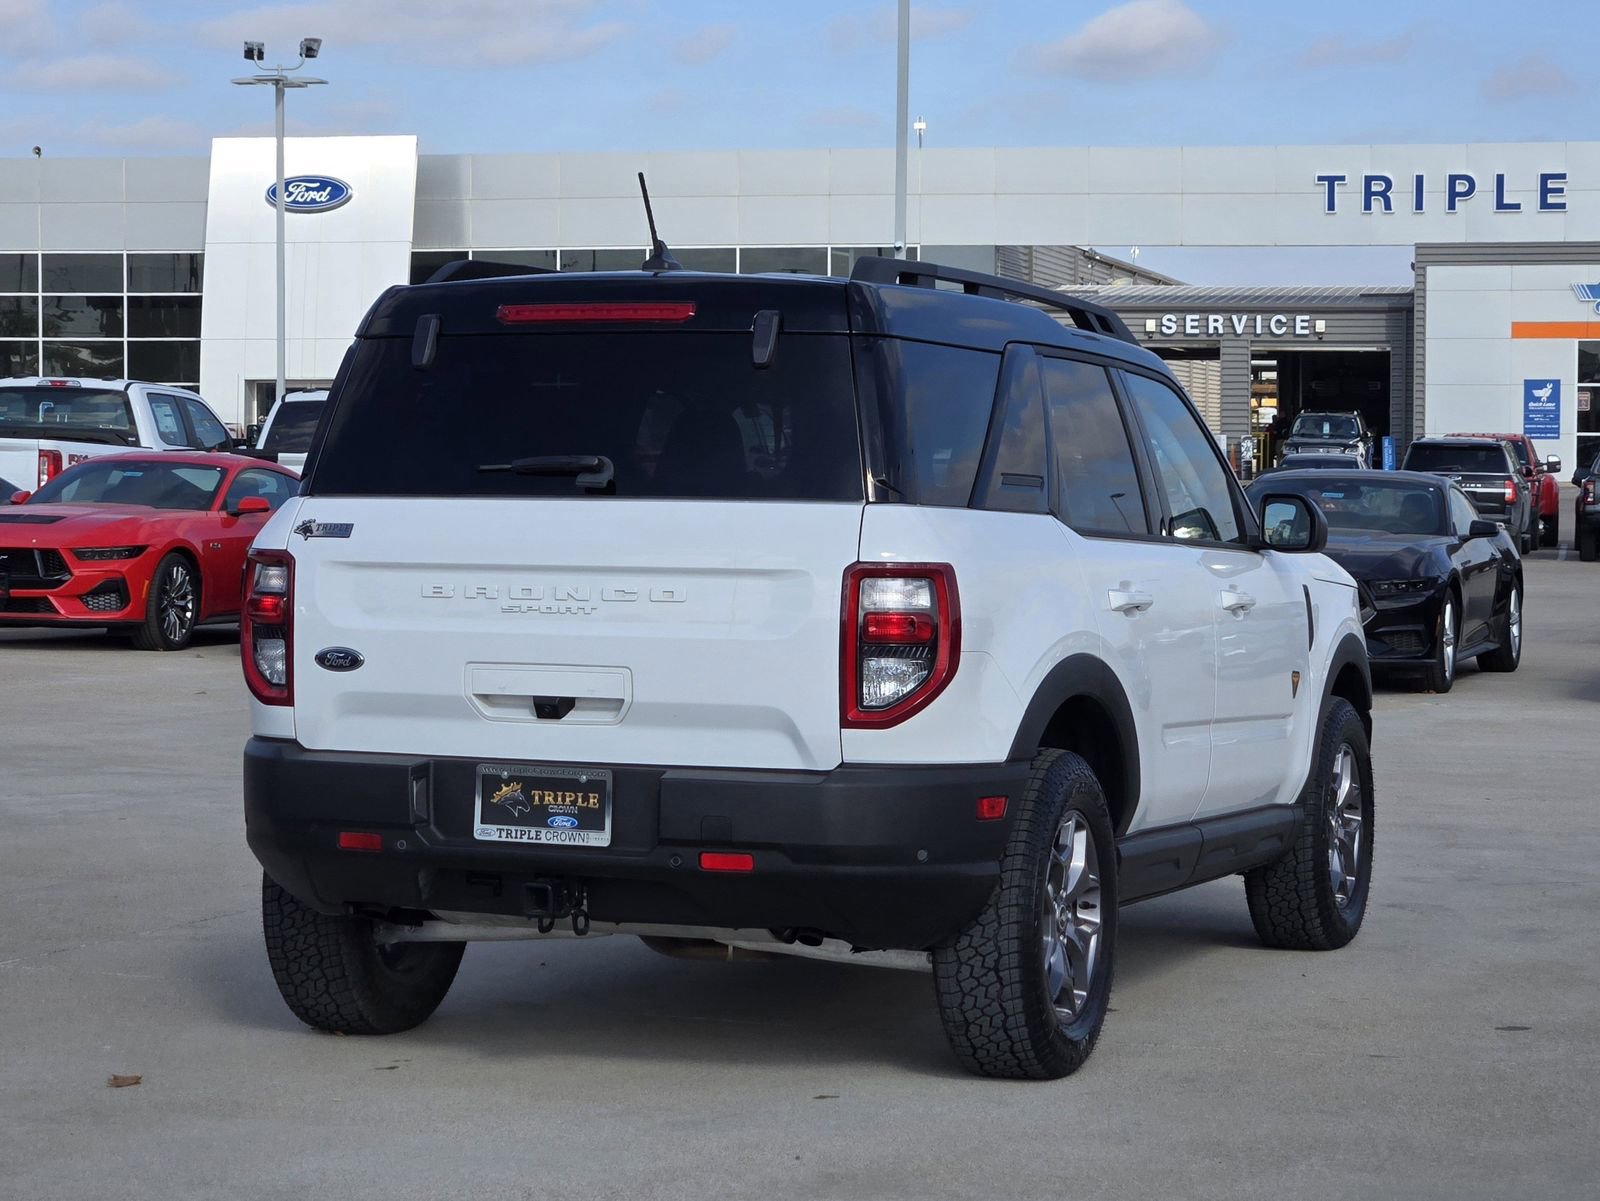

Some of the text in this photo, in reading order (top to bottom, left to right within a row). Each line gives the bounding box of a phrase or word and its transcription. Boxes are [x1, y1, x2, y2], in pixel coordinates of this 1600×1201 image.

[284, 182, 331, 202] Ford
[1315, 172, 1568, 213] TRIPLE
[1161, 314, 1310, 336] SERVICE
[421, 583, 687, 602] BRONCO
[501, 604, 598, 614] SPORT
[325, 652, 352, 667] Ford
[531, 790, 600, 809] TRIPLE
[548, 804, 578, 814] CROWN
[553, 818, 573, 827] Ford
[496, 828, 542, 840] TRIPLE
[545, 831, 585, 843] CROWN
